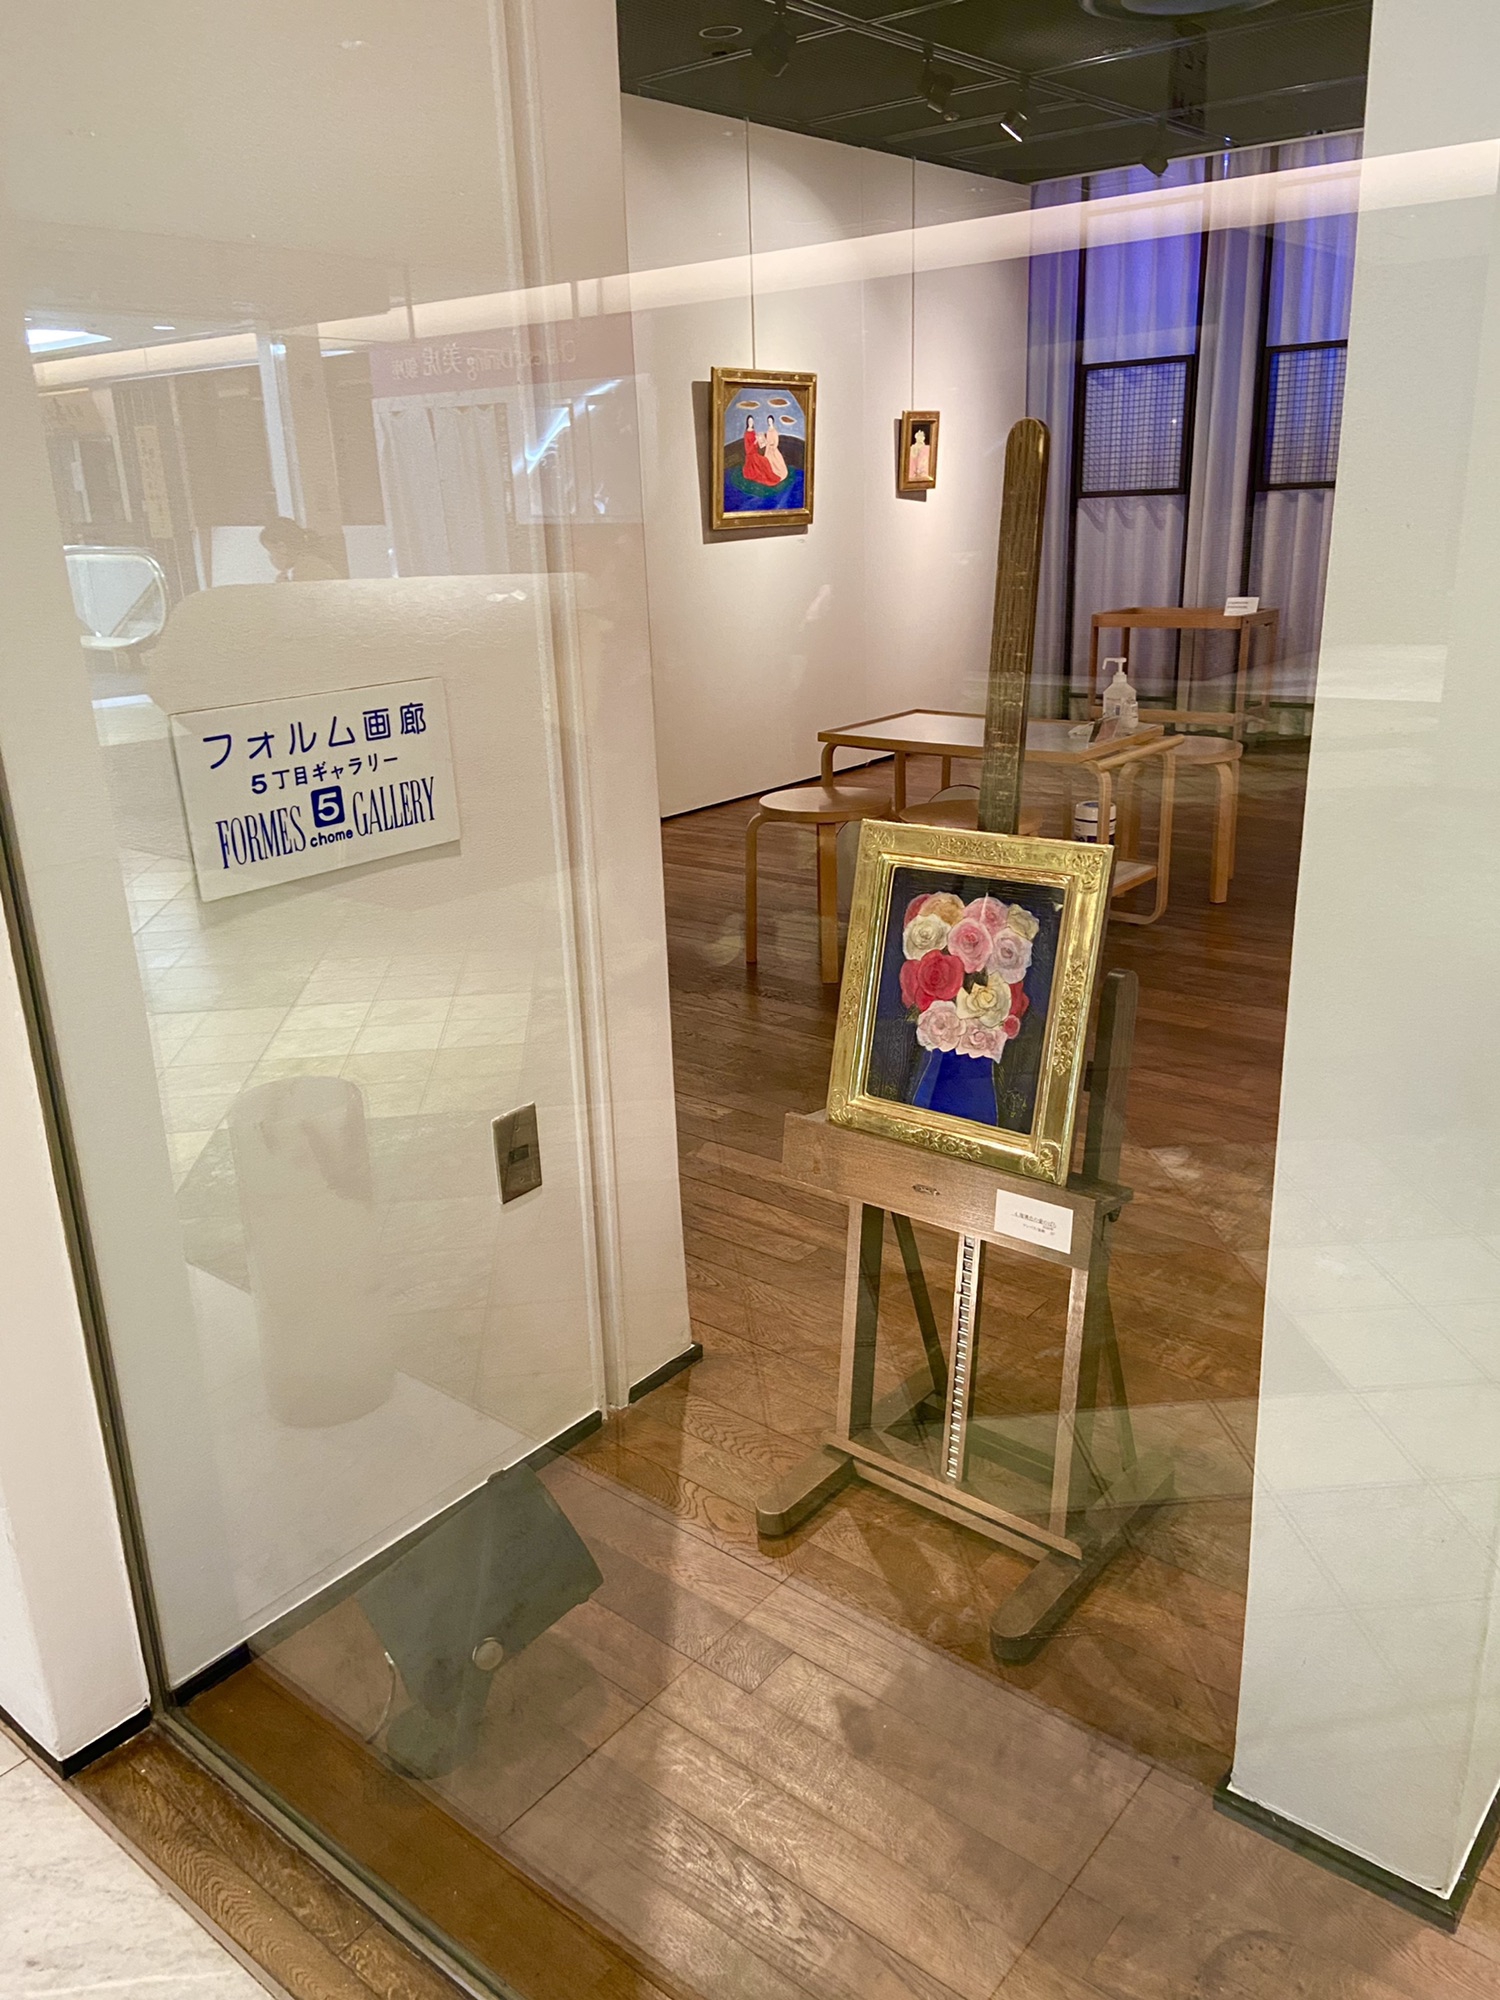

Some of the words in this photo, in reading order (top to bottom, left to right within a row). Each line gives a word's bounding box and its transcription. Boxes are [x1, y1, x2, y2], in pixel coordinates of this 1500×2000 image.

[203, 702, 427, 770] フォルム画廊
[250, 753, 399, 795] 5丁目ギャラリー
[315, 789, 343, 823] 5
[352, 775, 436, 838] GALLERY
[215, 804, 308, 870] FORMES
[309, 828, 354, 848] chome
